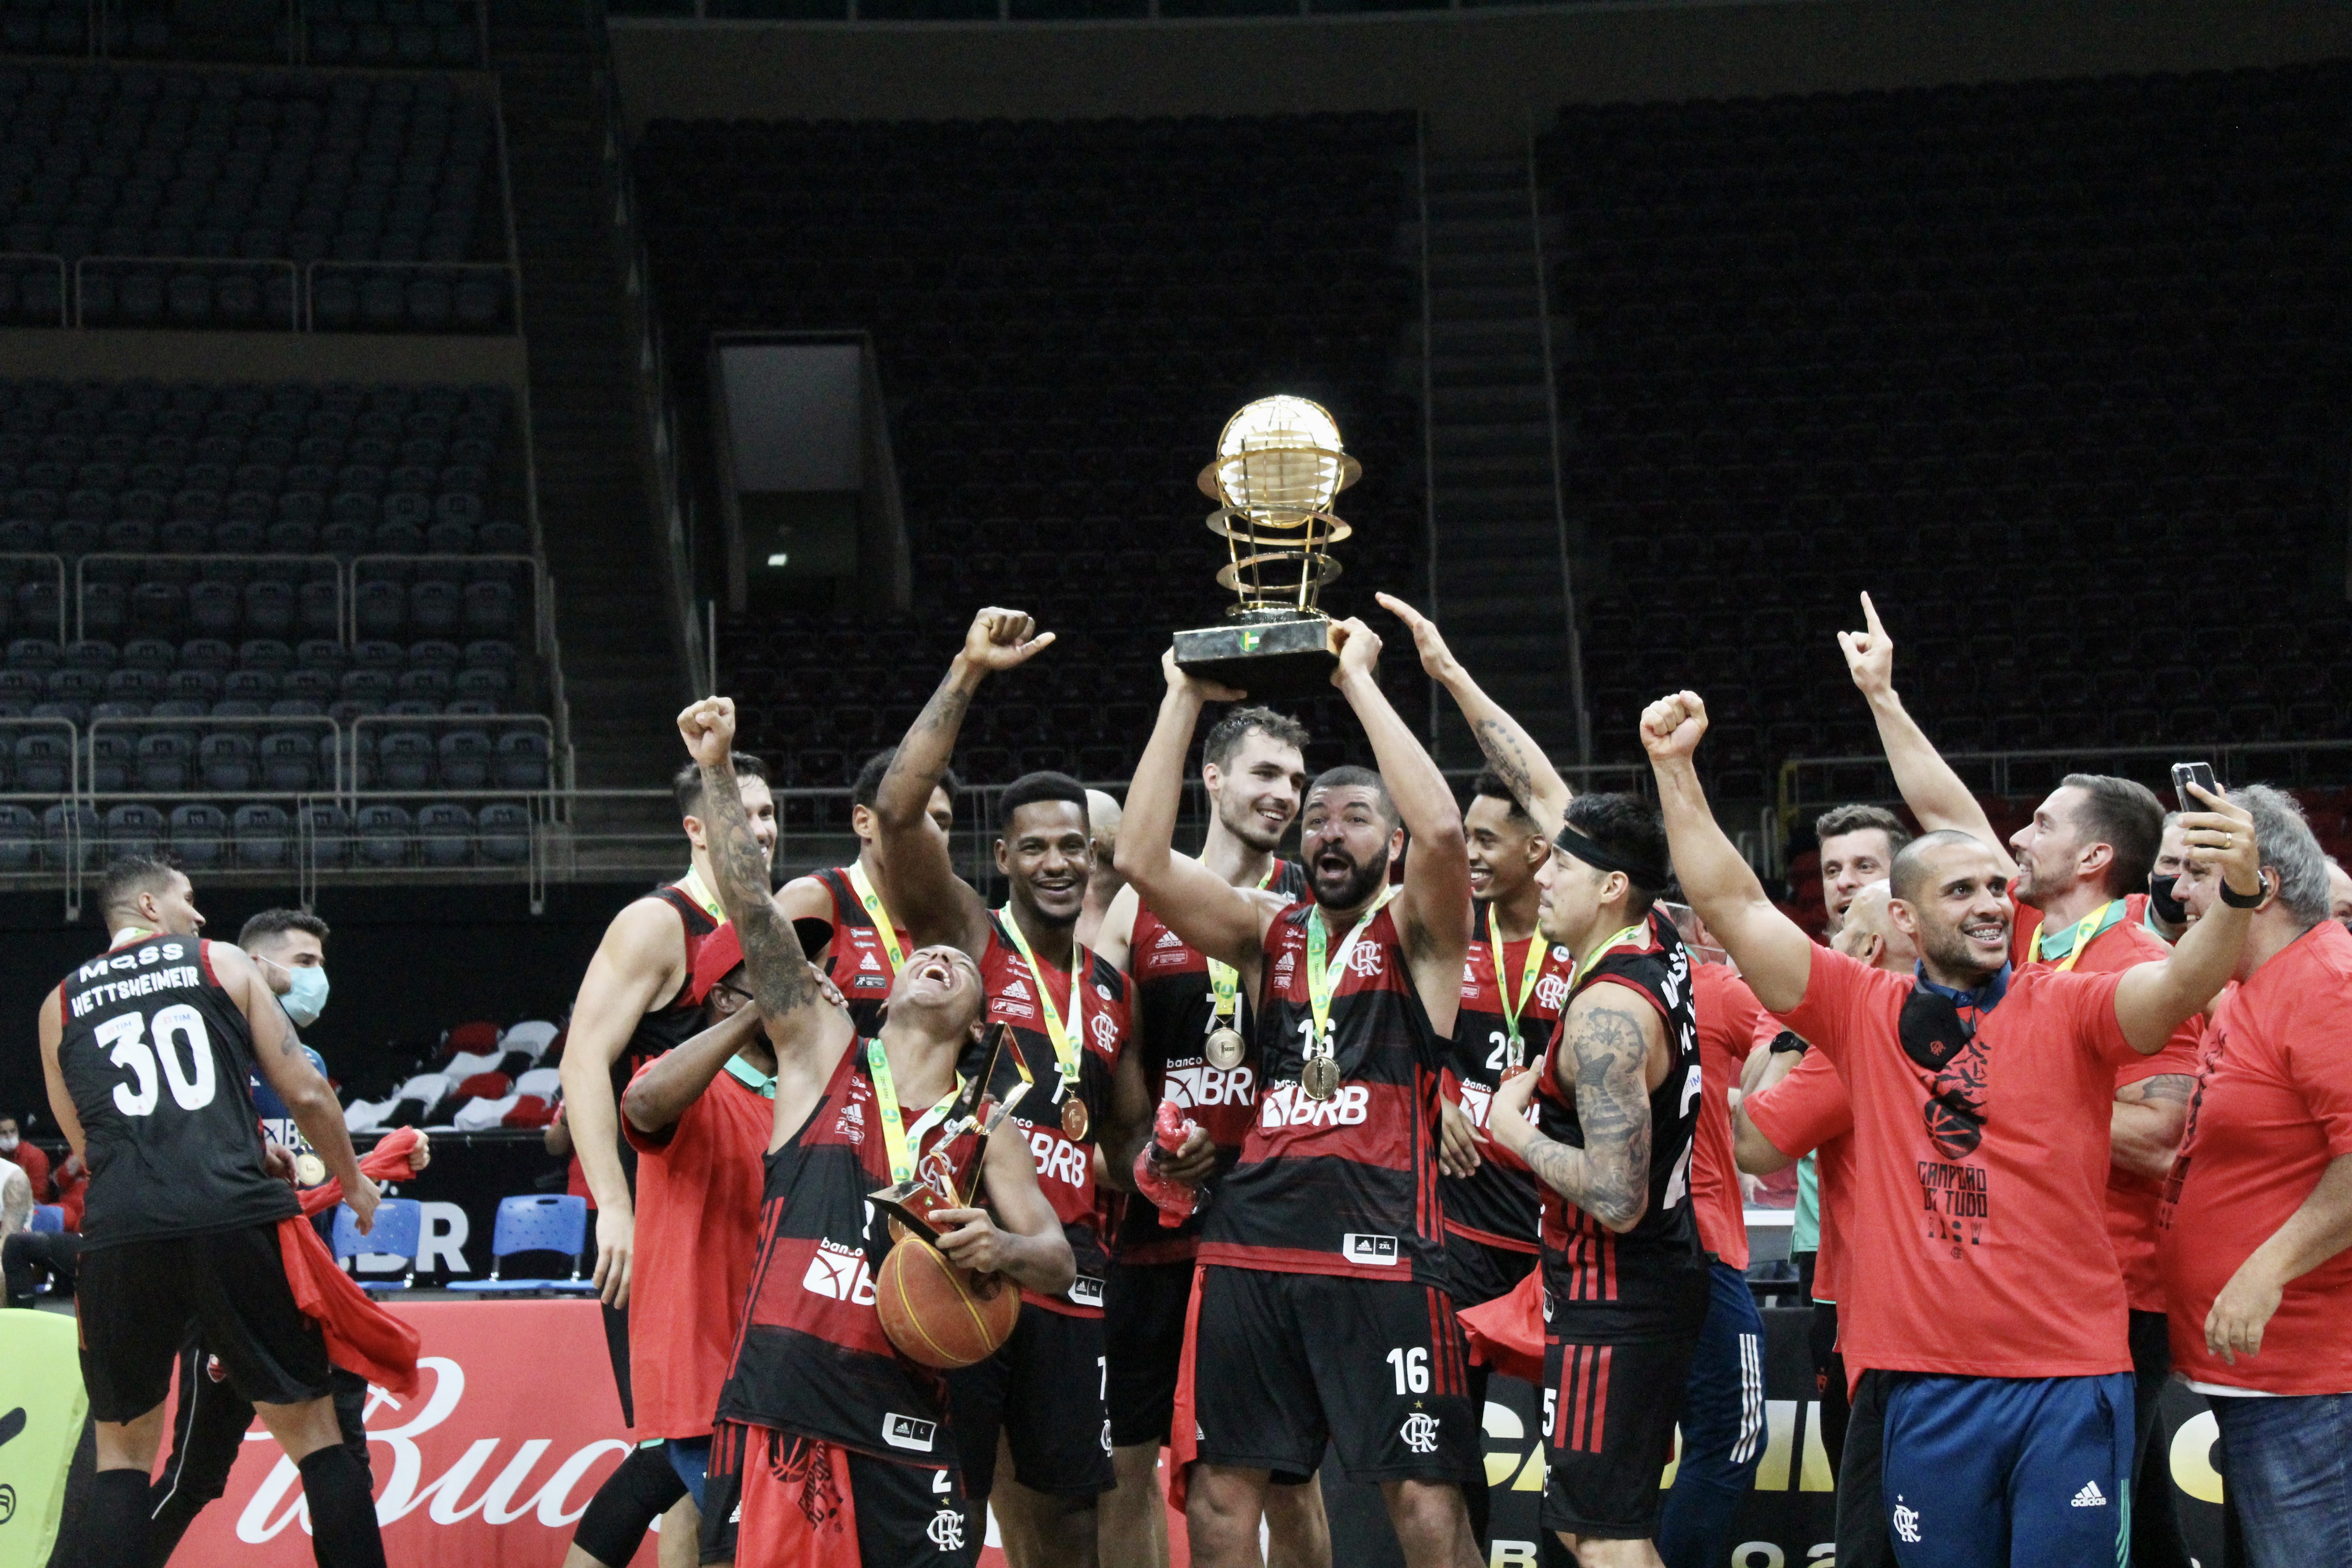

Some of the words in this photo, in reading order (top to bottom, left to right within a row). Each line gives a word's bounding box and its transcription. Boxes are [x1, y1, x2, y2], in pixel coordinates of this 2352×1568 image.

[1155, 940, 1182, 949] adidas
[71, 966, 200, 1018] HETTSHEIMEIR
[1002, 990, 1031, 1001] adidas
[116, 1021, 132, 1031] TIM
[174, 1014, 191, 1023] TIM
[1297, 1018, 1336, 1061] 16
[1485, 1031, 1525, 1070] 20
[94, 1004, 216, 1117] 30
[1166, 1057, 1203, 1068] banco
[1198, 1067, 1255, 1106] BR
[1462, 1078, 1492, 1093] banco
[1290, 1086, 1369, 1127] BRB
[1030, 1132, 1086, 1188] BRB
[1945, 1190, 1988, 1218] TUDO
[1386, 1347, 1429, 1395] 16
[2071, 1497, 2107, 1507] adidas
